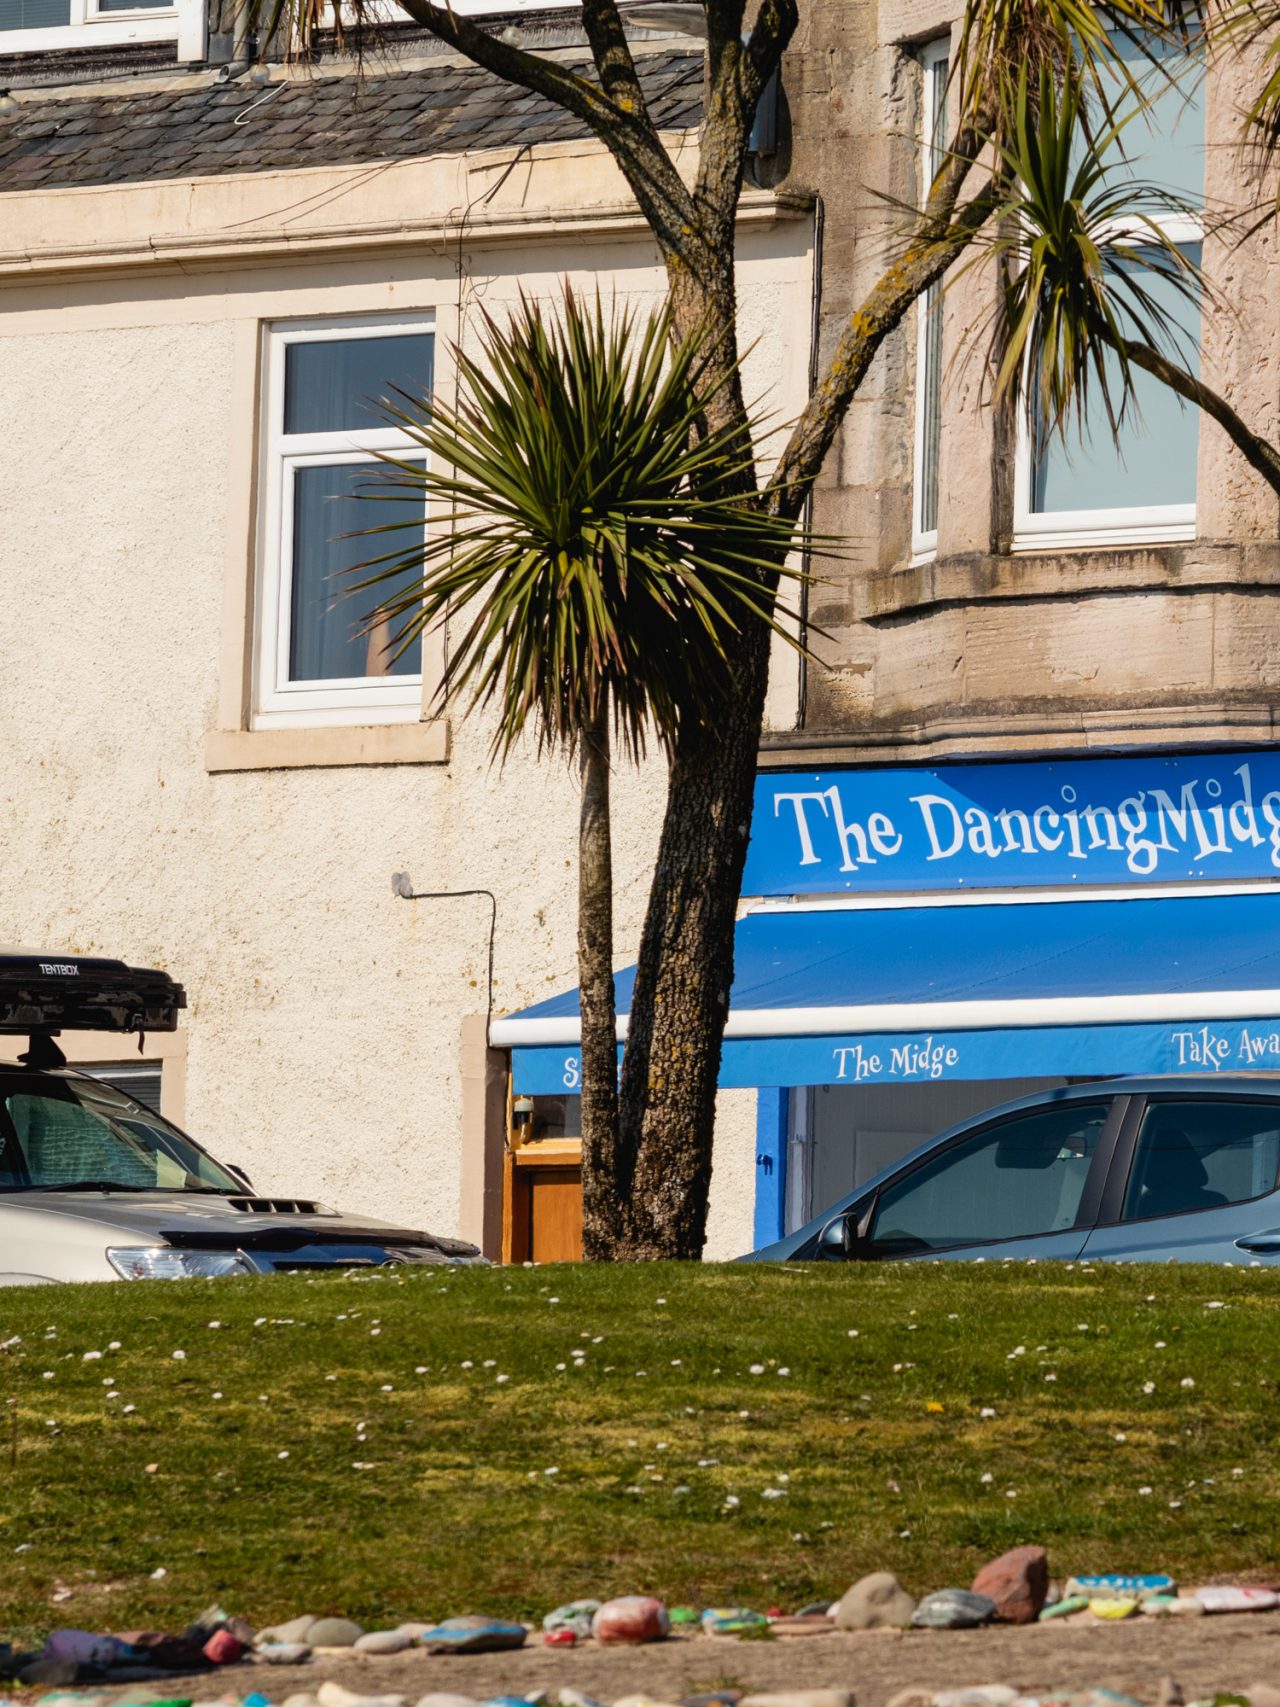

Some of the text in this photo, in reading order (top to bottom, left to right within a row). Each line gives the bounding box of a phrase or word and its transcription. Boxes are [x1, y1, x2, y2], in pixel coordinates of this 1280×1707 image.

[774, 785, 902, 872] The
[39, 963, 80, 976] TENTBOX
[832, 1036, 960, 1081] The Midge
[1170, 1025, 1232, 1072] Take
